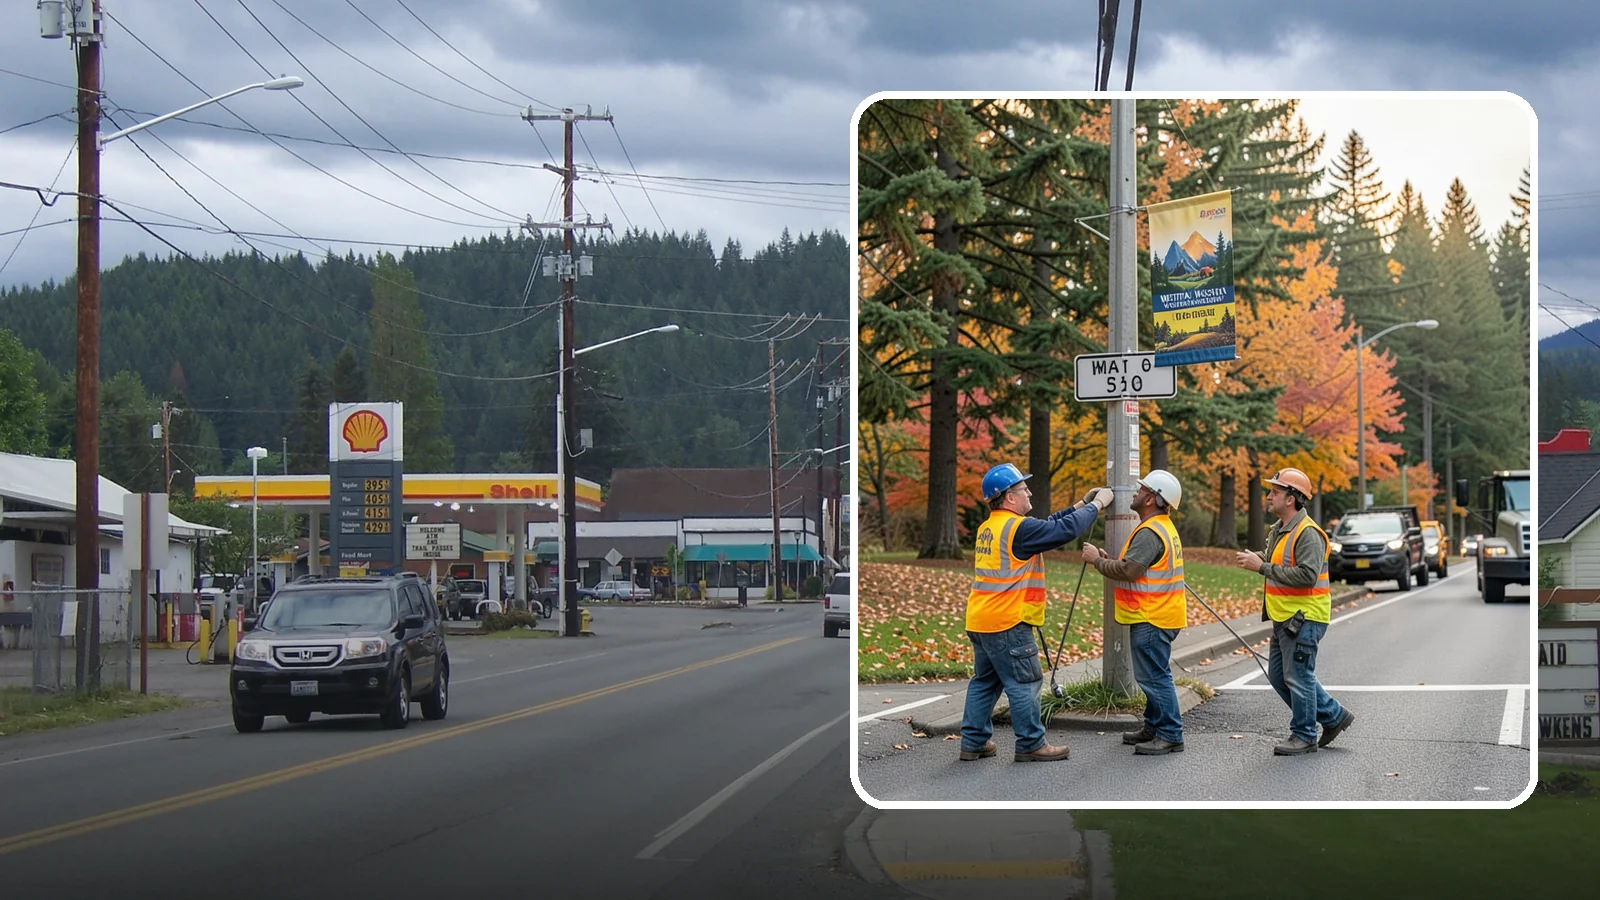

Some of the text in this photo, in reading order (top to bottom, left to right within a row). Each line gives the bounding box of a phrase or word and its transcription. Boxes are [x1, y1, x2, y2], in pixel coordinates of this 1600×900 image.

[366, 480, 384, 490] 395
[490, 484, 547, 499] Shell
[366, 494, 384, 504] 405
[366, 508, 384, 518] 415
[366, 522, 384, 532] 429
[1539, 642, 1567, 665] AID
